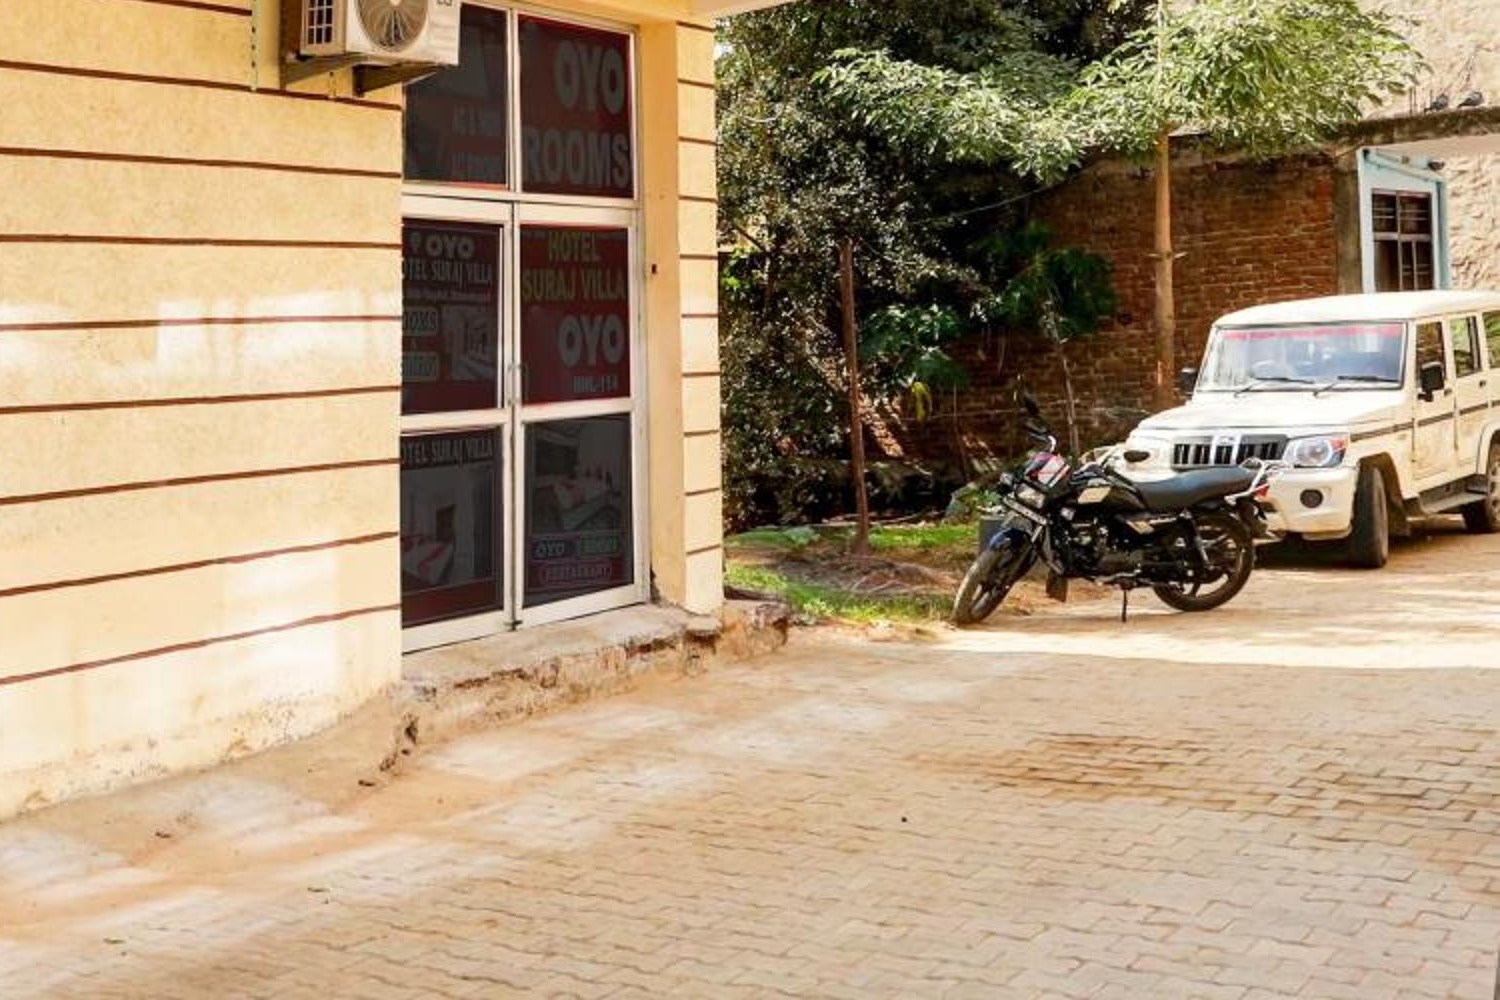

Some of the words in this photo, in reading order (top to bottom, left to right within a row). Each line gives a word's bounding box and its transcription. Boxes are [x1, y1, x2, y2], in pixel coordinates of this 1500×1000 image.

[554, 40, 625, 114] OYO
[524, 126, 630, 188] ROOMS
[426, 232, 474, 259] OYO
[548, 230, 600, 262] HOTEL
[522, 268, 576, 301] SURAJ
[580, 267, 626, 299] VILLA
[558, 313, 624, 367] OYO
